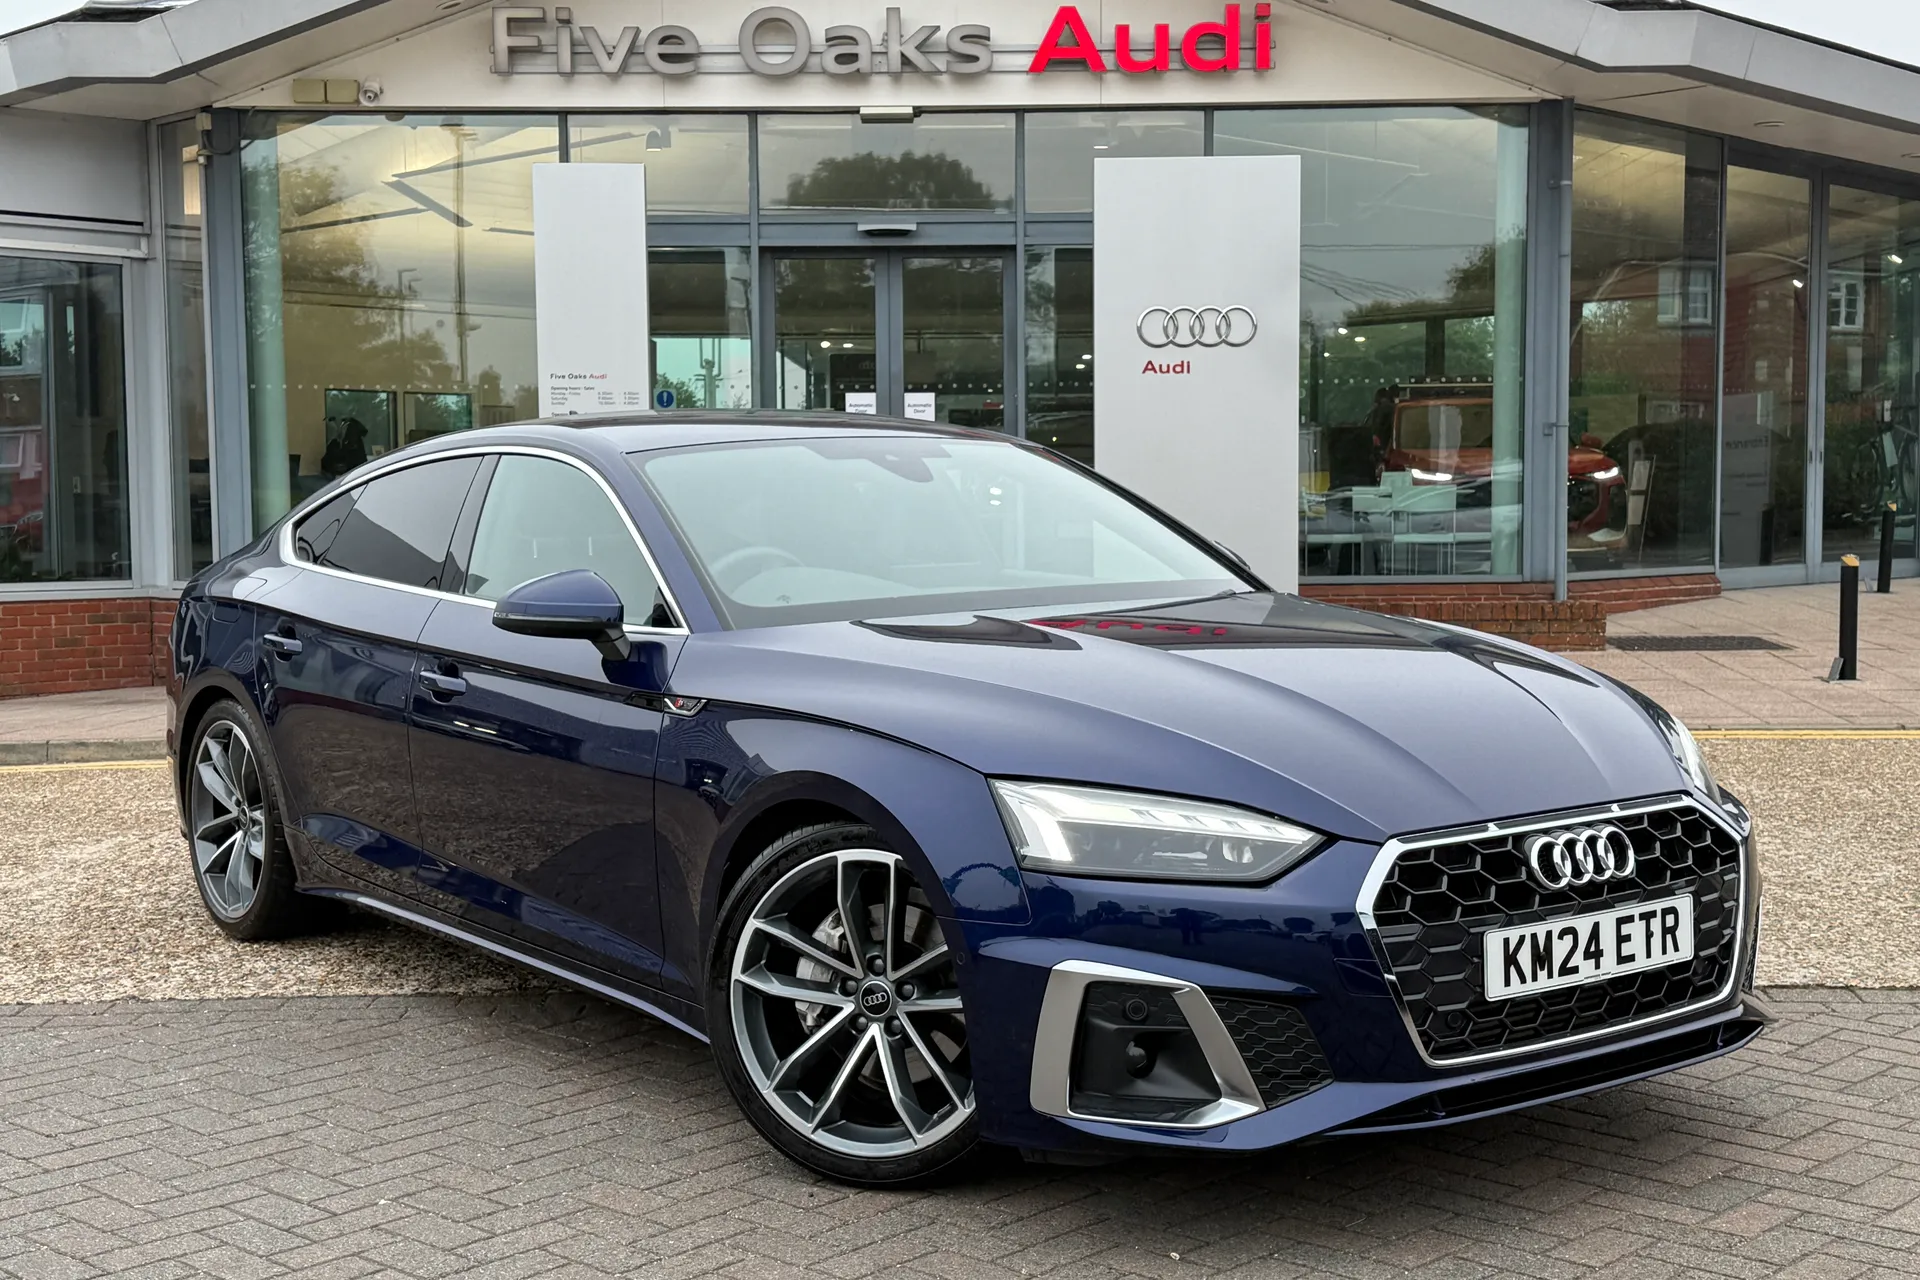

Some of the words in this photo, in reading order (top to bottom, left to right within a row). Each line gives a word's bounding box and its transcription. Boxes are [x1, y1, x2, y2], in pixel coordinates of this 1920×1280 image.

[491, 6, 698, 76] Five
[737, 6, 992, 76] Oaks
[1028, 3, 1271, 74] Audi
[1142, 360, 1191, 374] Audi
[1503, 921, 1604, 988] KM24
[1615, 906, 1680, 966] ETR
